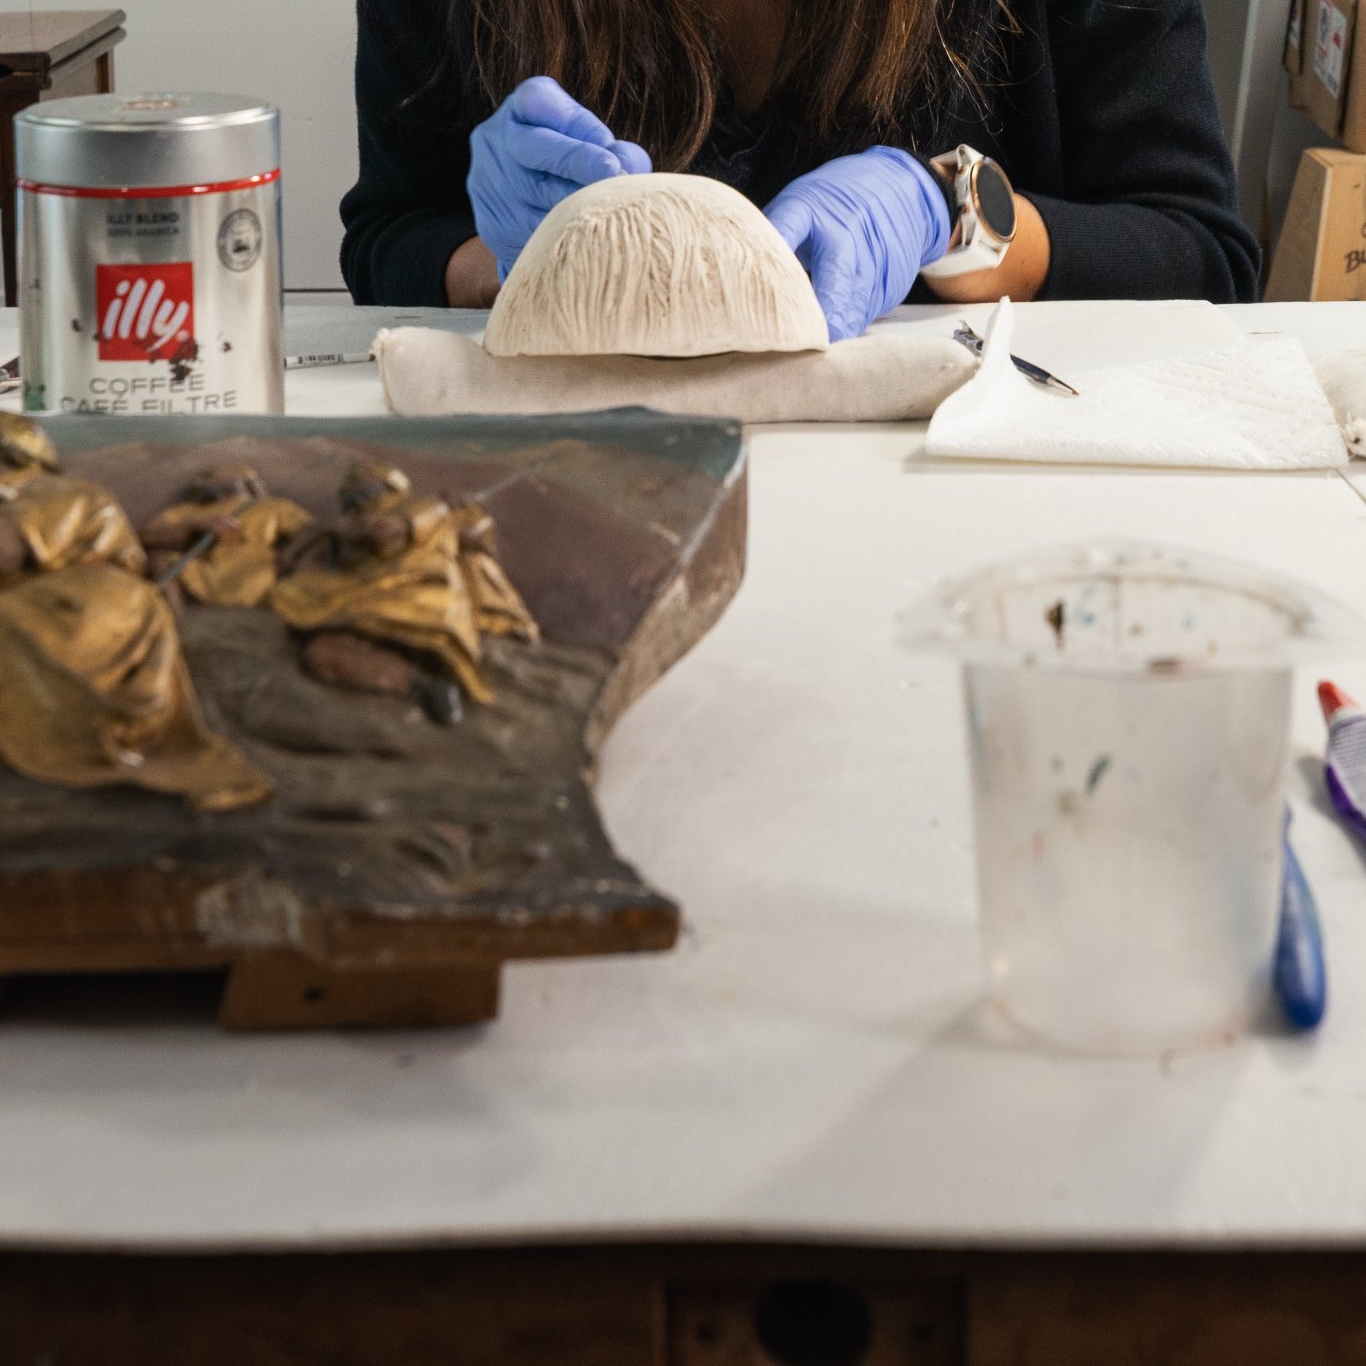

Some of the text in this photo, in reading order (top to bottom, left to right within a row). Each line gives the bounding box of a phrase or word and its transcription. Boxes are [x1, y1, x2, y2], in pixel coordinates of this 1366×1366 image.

[102, 278, 190, 354] illy
[89, 373, 205, 395] COFFEE
[140, 390, 238, 414] FILTRE
